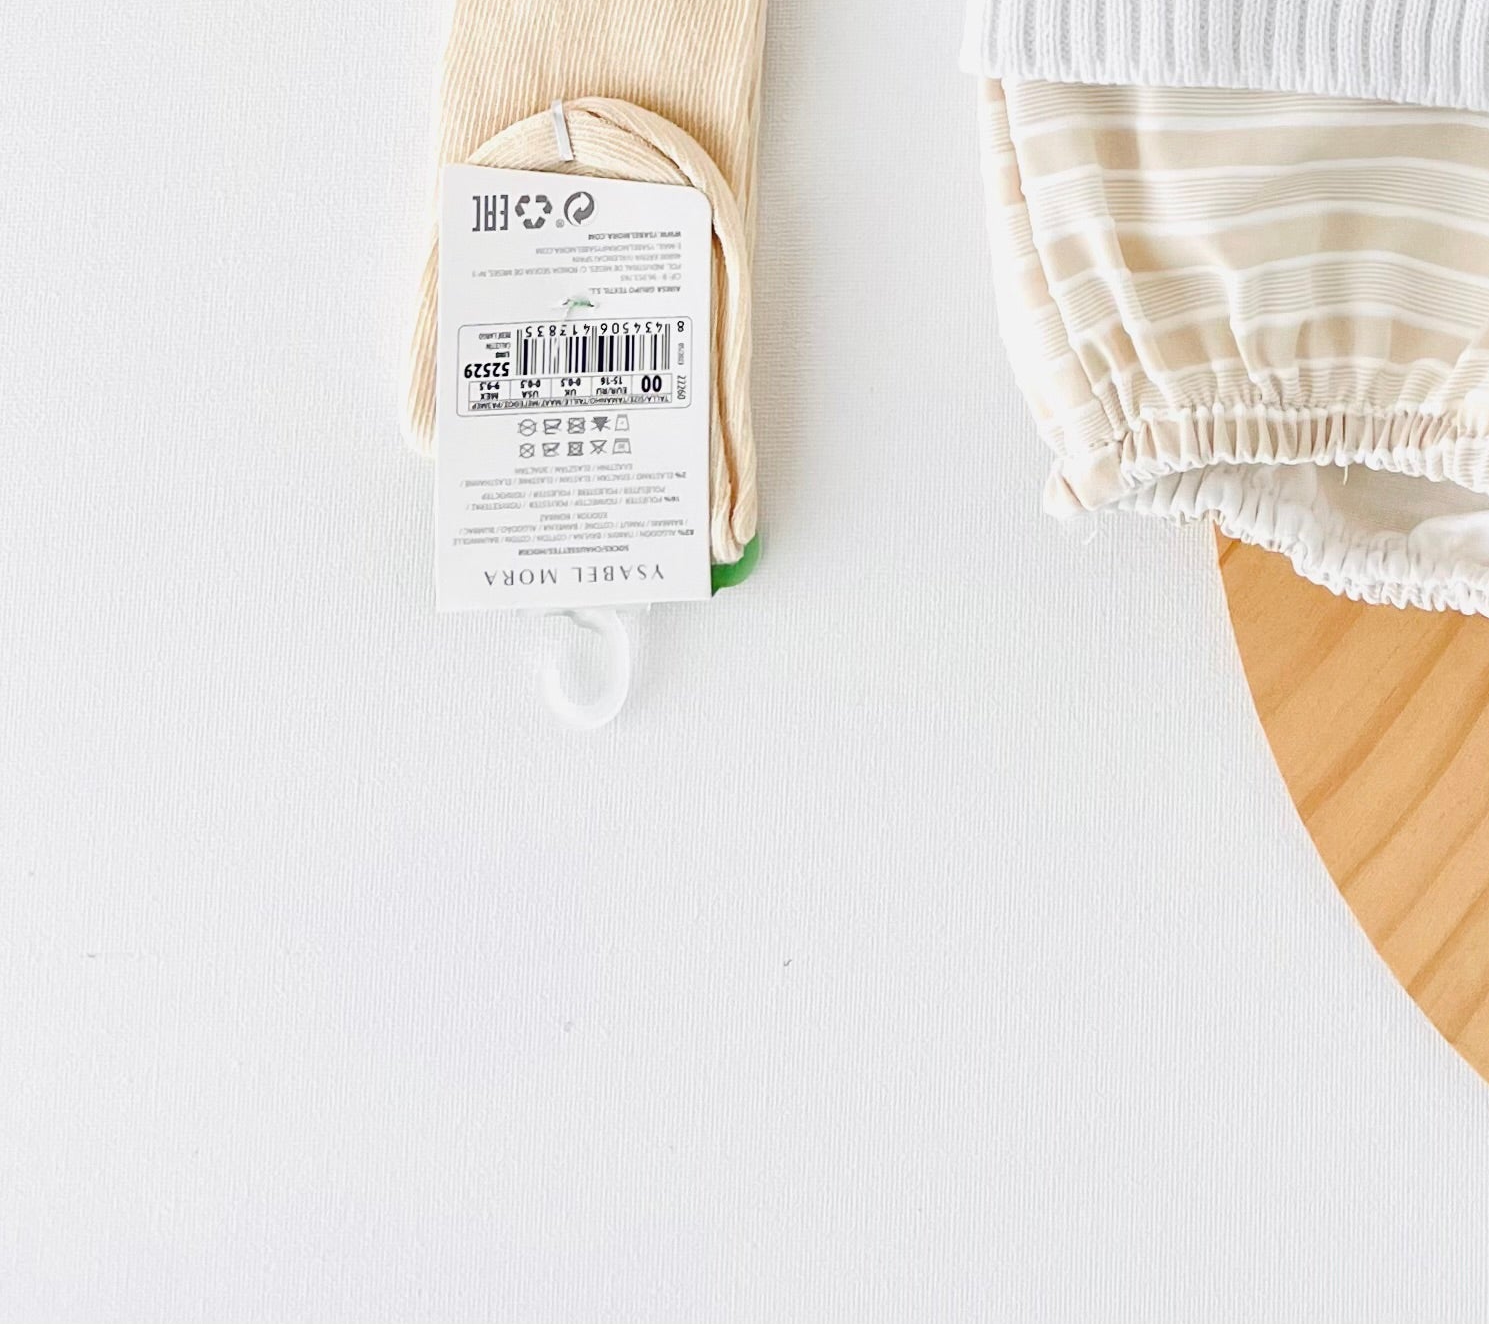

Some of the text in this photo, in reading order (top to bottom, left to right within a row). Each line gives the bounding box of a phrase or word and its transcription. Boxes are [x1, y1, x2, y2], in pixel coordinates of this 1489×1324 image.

[526, 321, 684, 337] 8 434506 413835
[464, 362, 510, 379] 52529
[601, 377, 622, 385] 15-16
[642, 375, 662, 393] 00
[480, 393, 498, 401] MEX
[522, 391, 539, 399] USA
[596, 387, 627, 395] EUR/RU
[484, 564, 664, 587] YSABEL MORA
